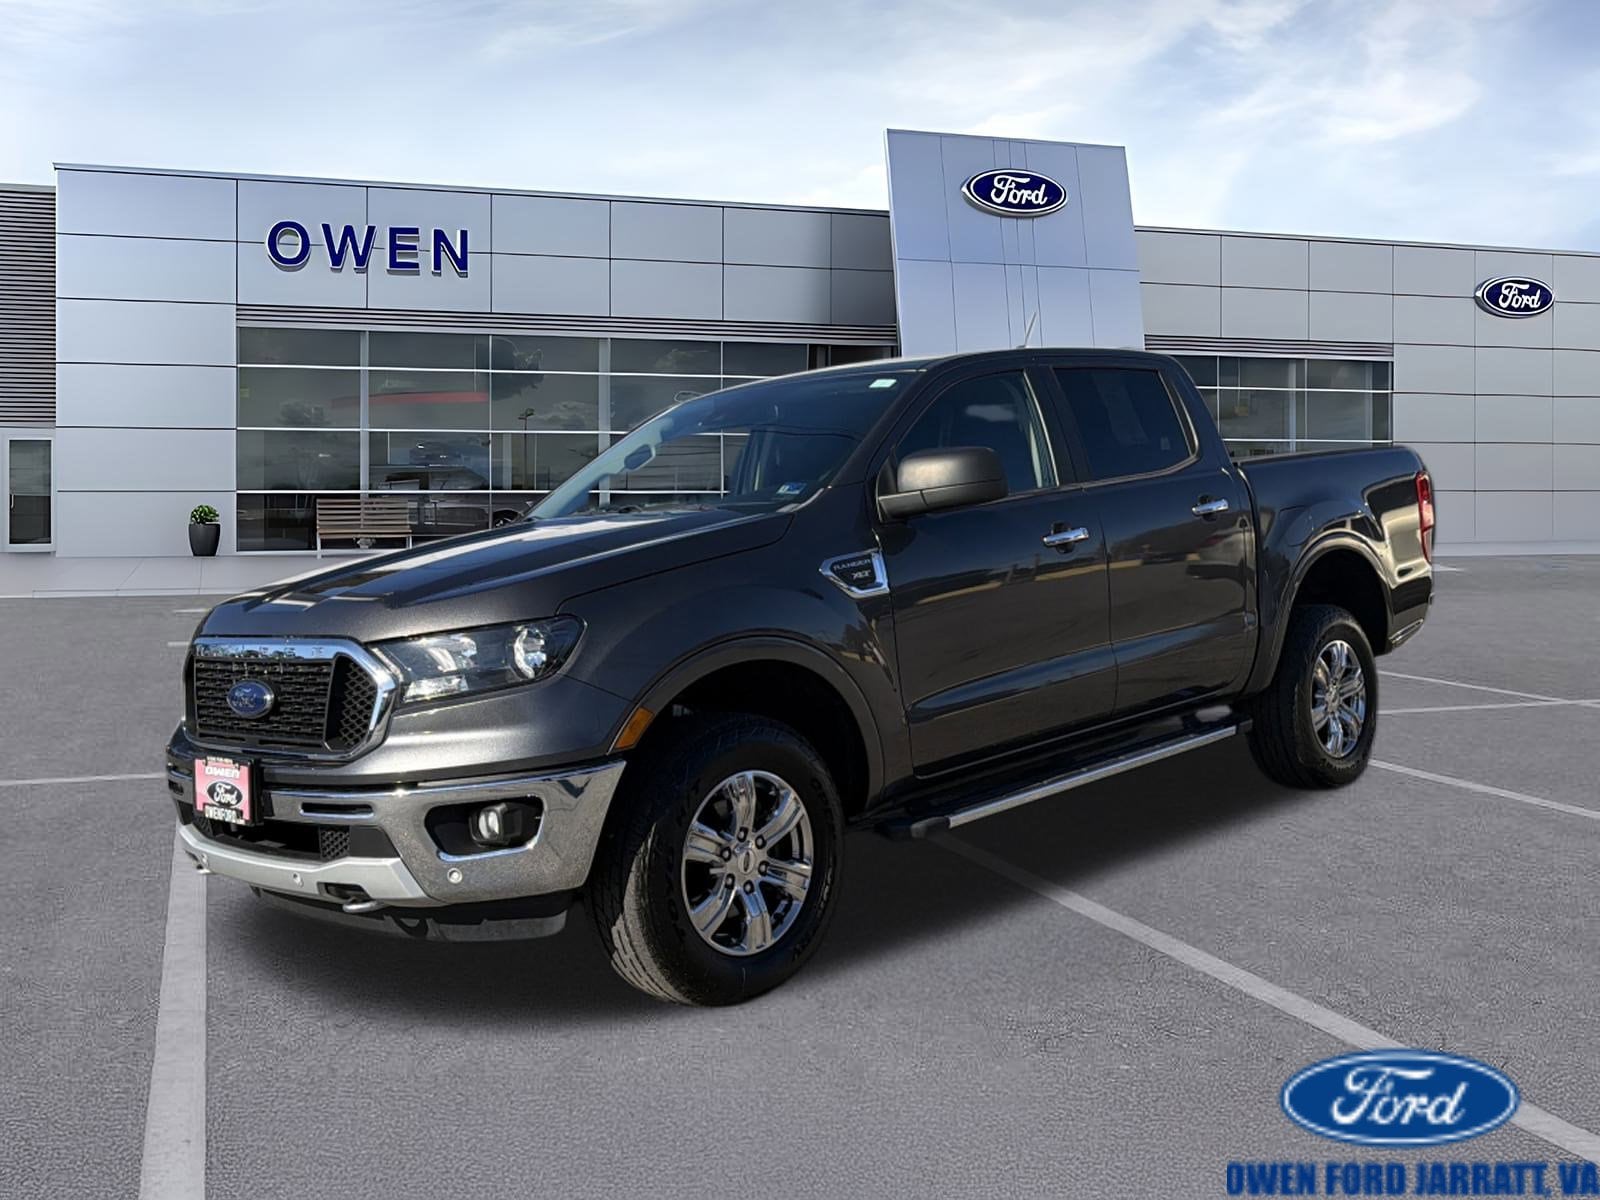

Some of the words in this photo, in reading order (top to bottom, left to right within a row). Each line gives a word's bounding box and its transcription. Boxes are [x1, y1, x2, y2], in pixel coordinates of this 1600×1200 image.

[990, 174, 1048, 205] Ford
[266, 219, 471, 278] OWEN
[1498, 282, 1541, 308] Ford
[213, 782, 238, 805] Ford
